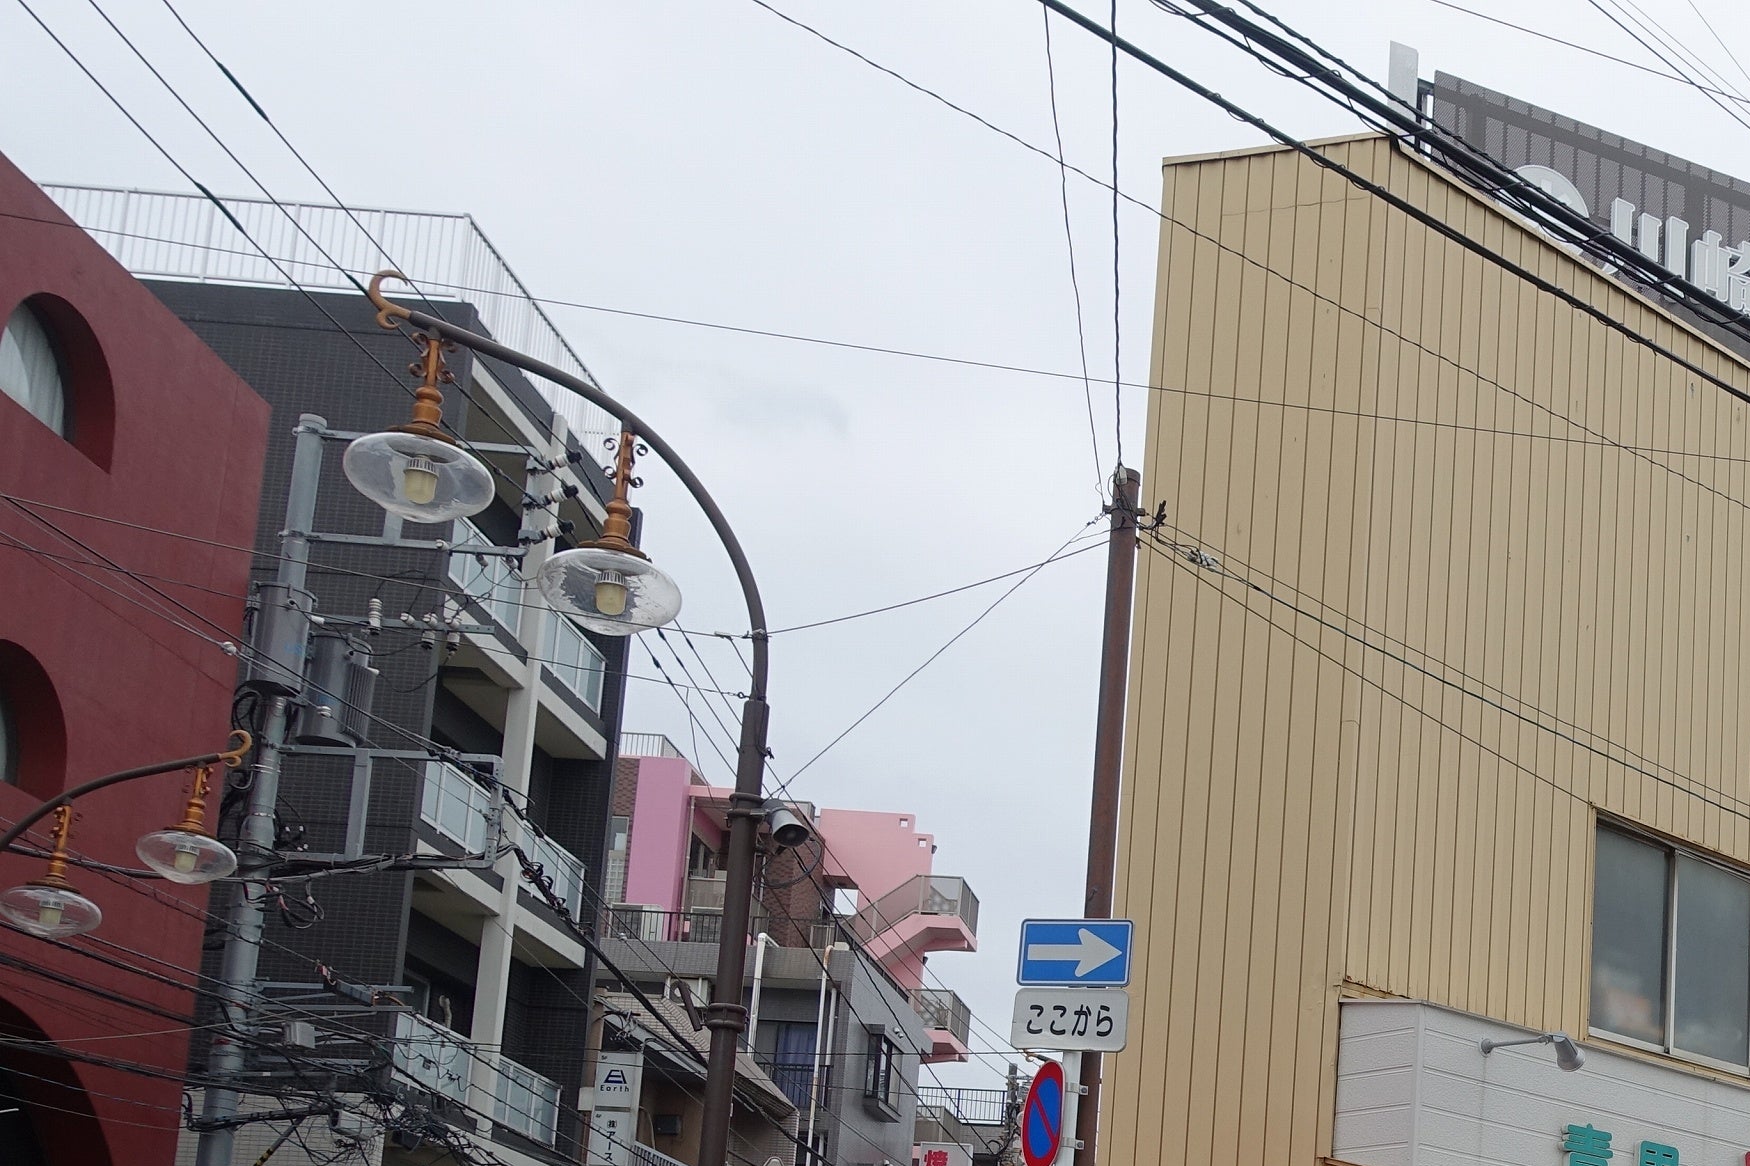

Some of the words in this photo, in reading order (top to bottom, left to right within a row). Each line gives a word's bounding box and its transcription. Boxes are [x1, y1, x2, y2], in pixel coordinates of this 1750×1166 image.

[1026, 1003, 1115, 1037] ここから
[600, 1084, 630, 1092] Earth
